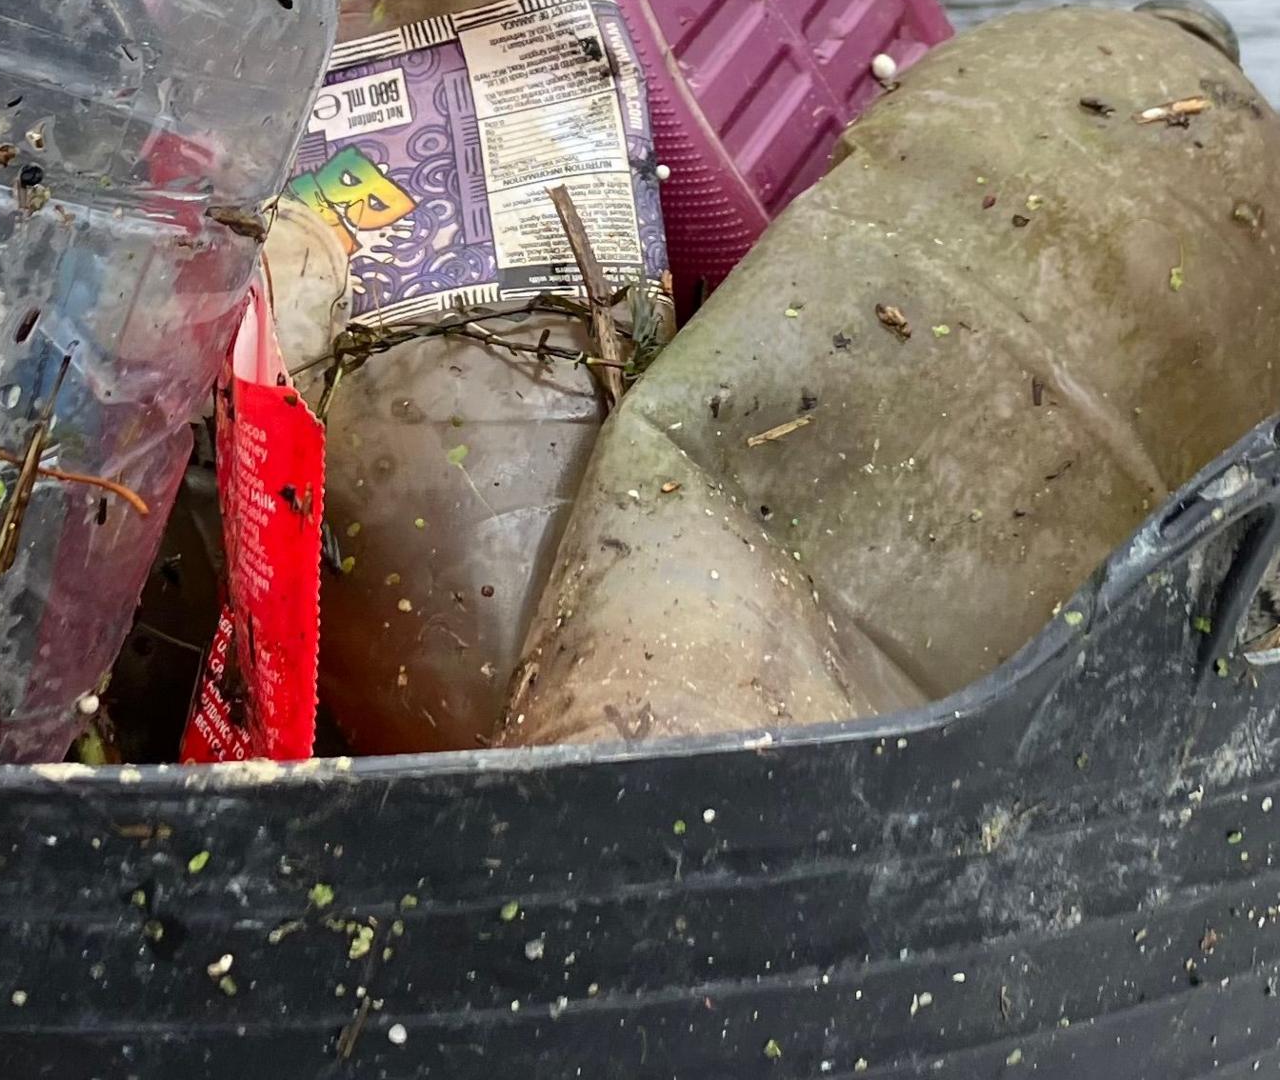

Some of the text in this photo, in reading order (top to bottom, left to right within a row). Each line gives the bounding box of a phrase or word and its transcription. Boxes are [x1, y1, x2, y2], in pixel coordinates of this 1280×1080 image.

[501, 3, 586, 29] PRODUCT OF JAMAICA
[519, 47, 545, 60] Kingdom
[509, 71, 527, 81] Foods
[557, 80, 609, 98] MANUFACTURED
[341, 87, 365, 113] mL
[347, 105, 403, 128] Net Content
[503, 160, 612, 185] NUTRITION INFORMATION
[529, 275, 546, 283] with
[250, 488, 276, 512] Milk
[229, 741, 247, 760] TO
